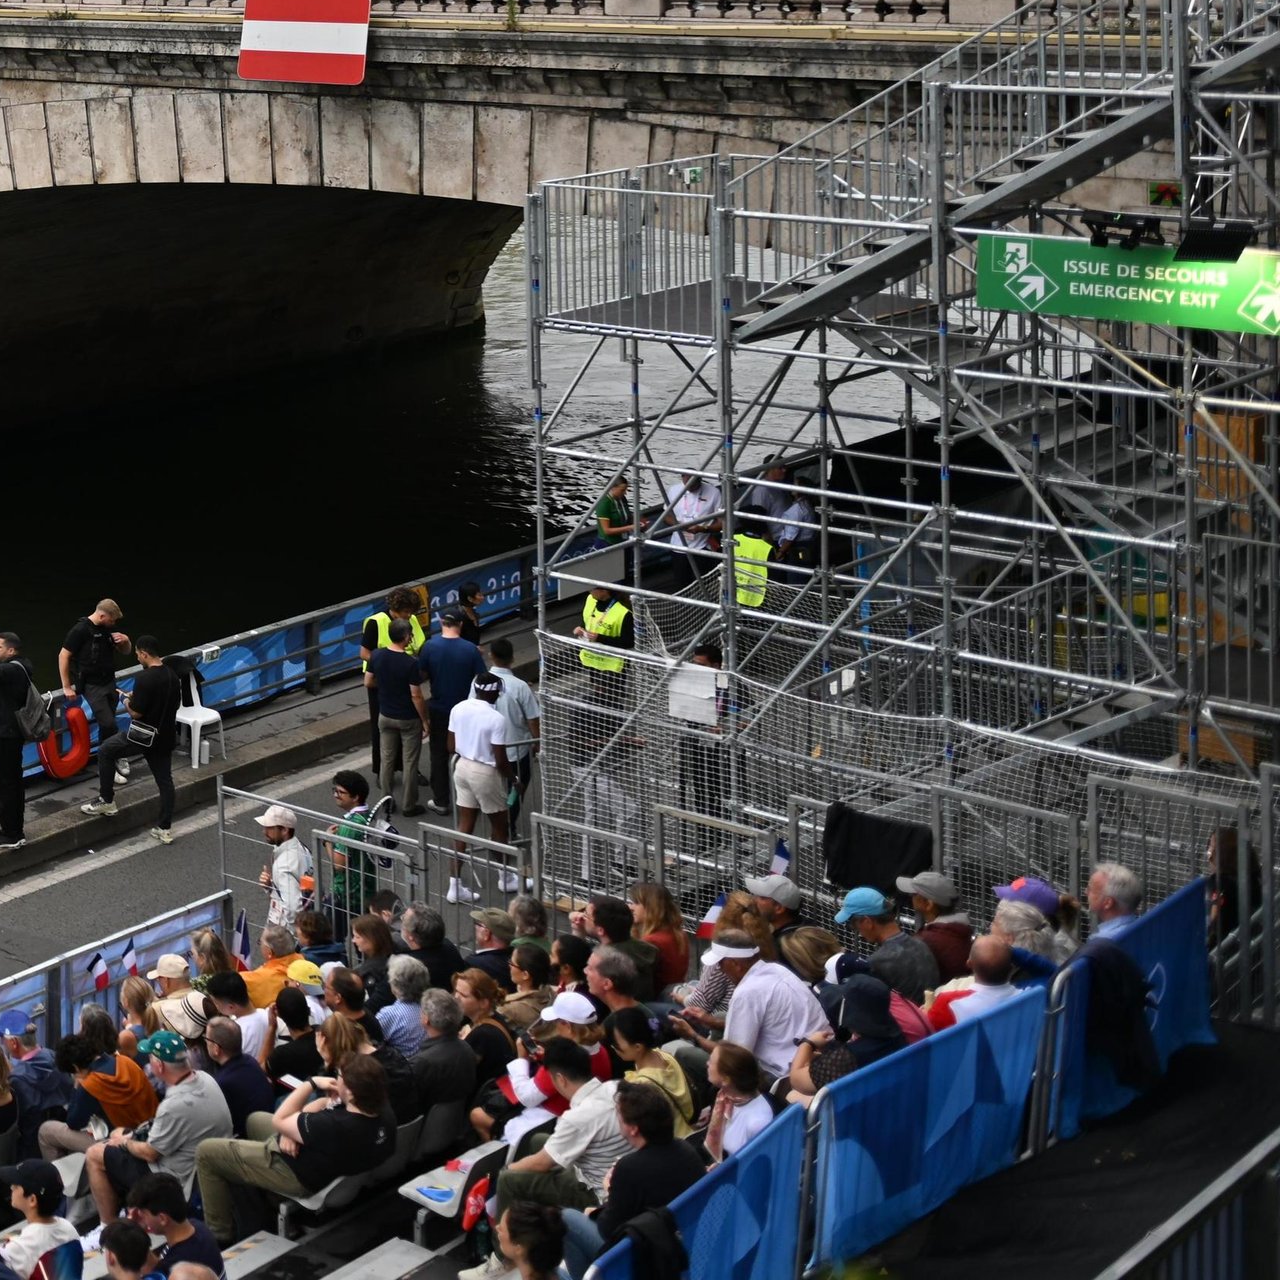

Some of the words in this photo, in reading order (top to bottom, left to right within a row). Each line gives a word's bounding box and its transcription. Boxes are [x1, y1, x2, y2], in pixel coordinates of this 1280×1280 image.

[1063, 259, 1110, 276] ISSUE
[1117, 264, 1140, 280] DE
[1144, 265, 1228, 287] SECOURS
[1069, 282, 1174, 304] EMERGENCY
[1178, 289, 1220, 309] EXIT
